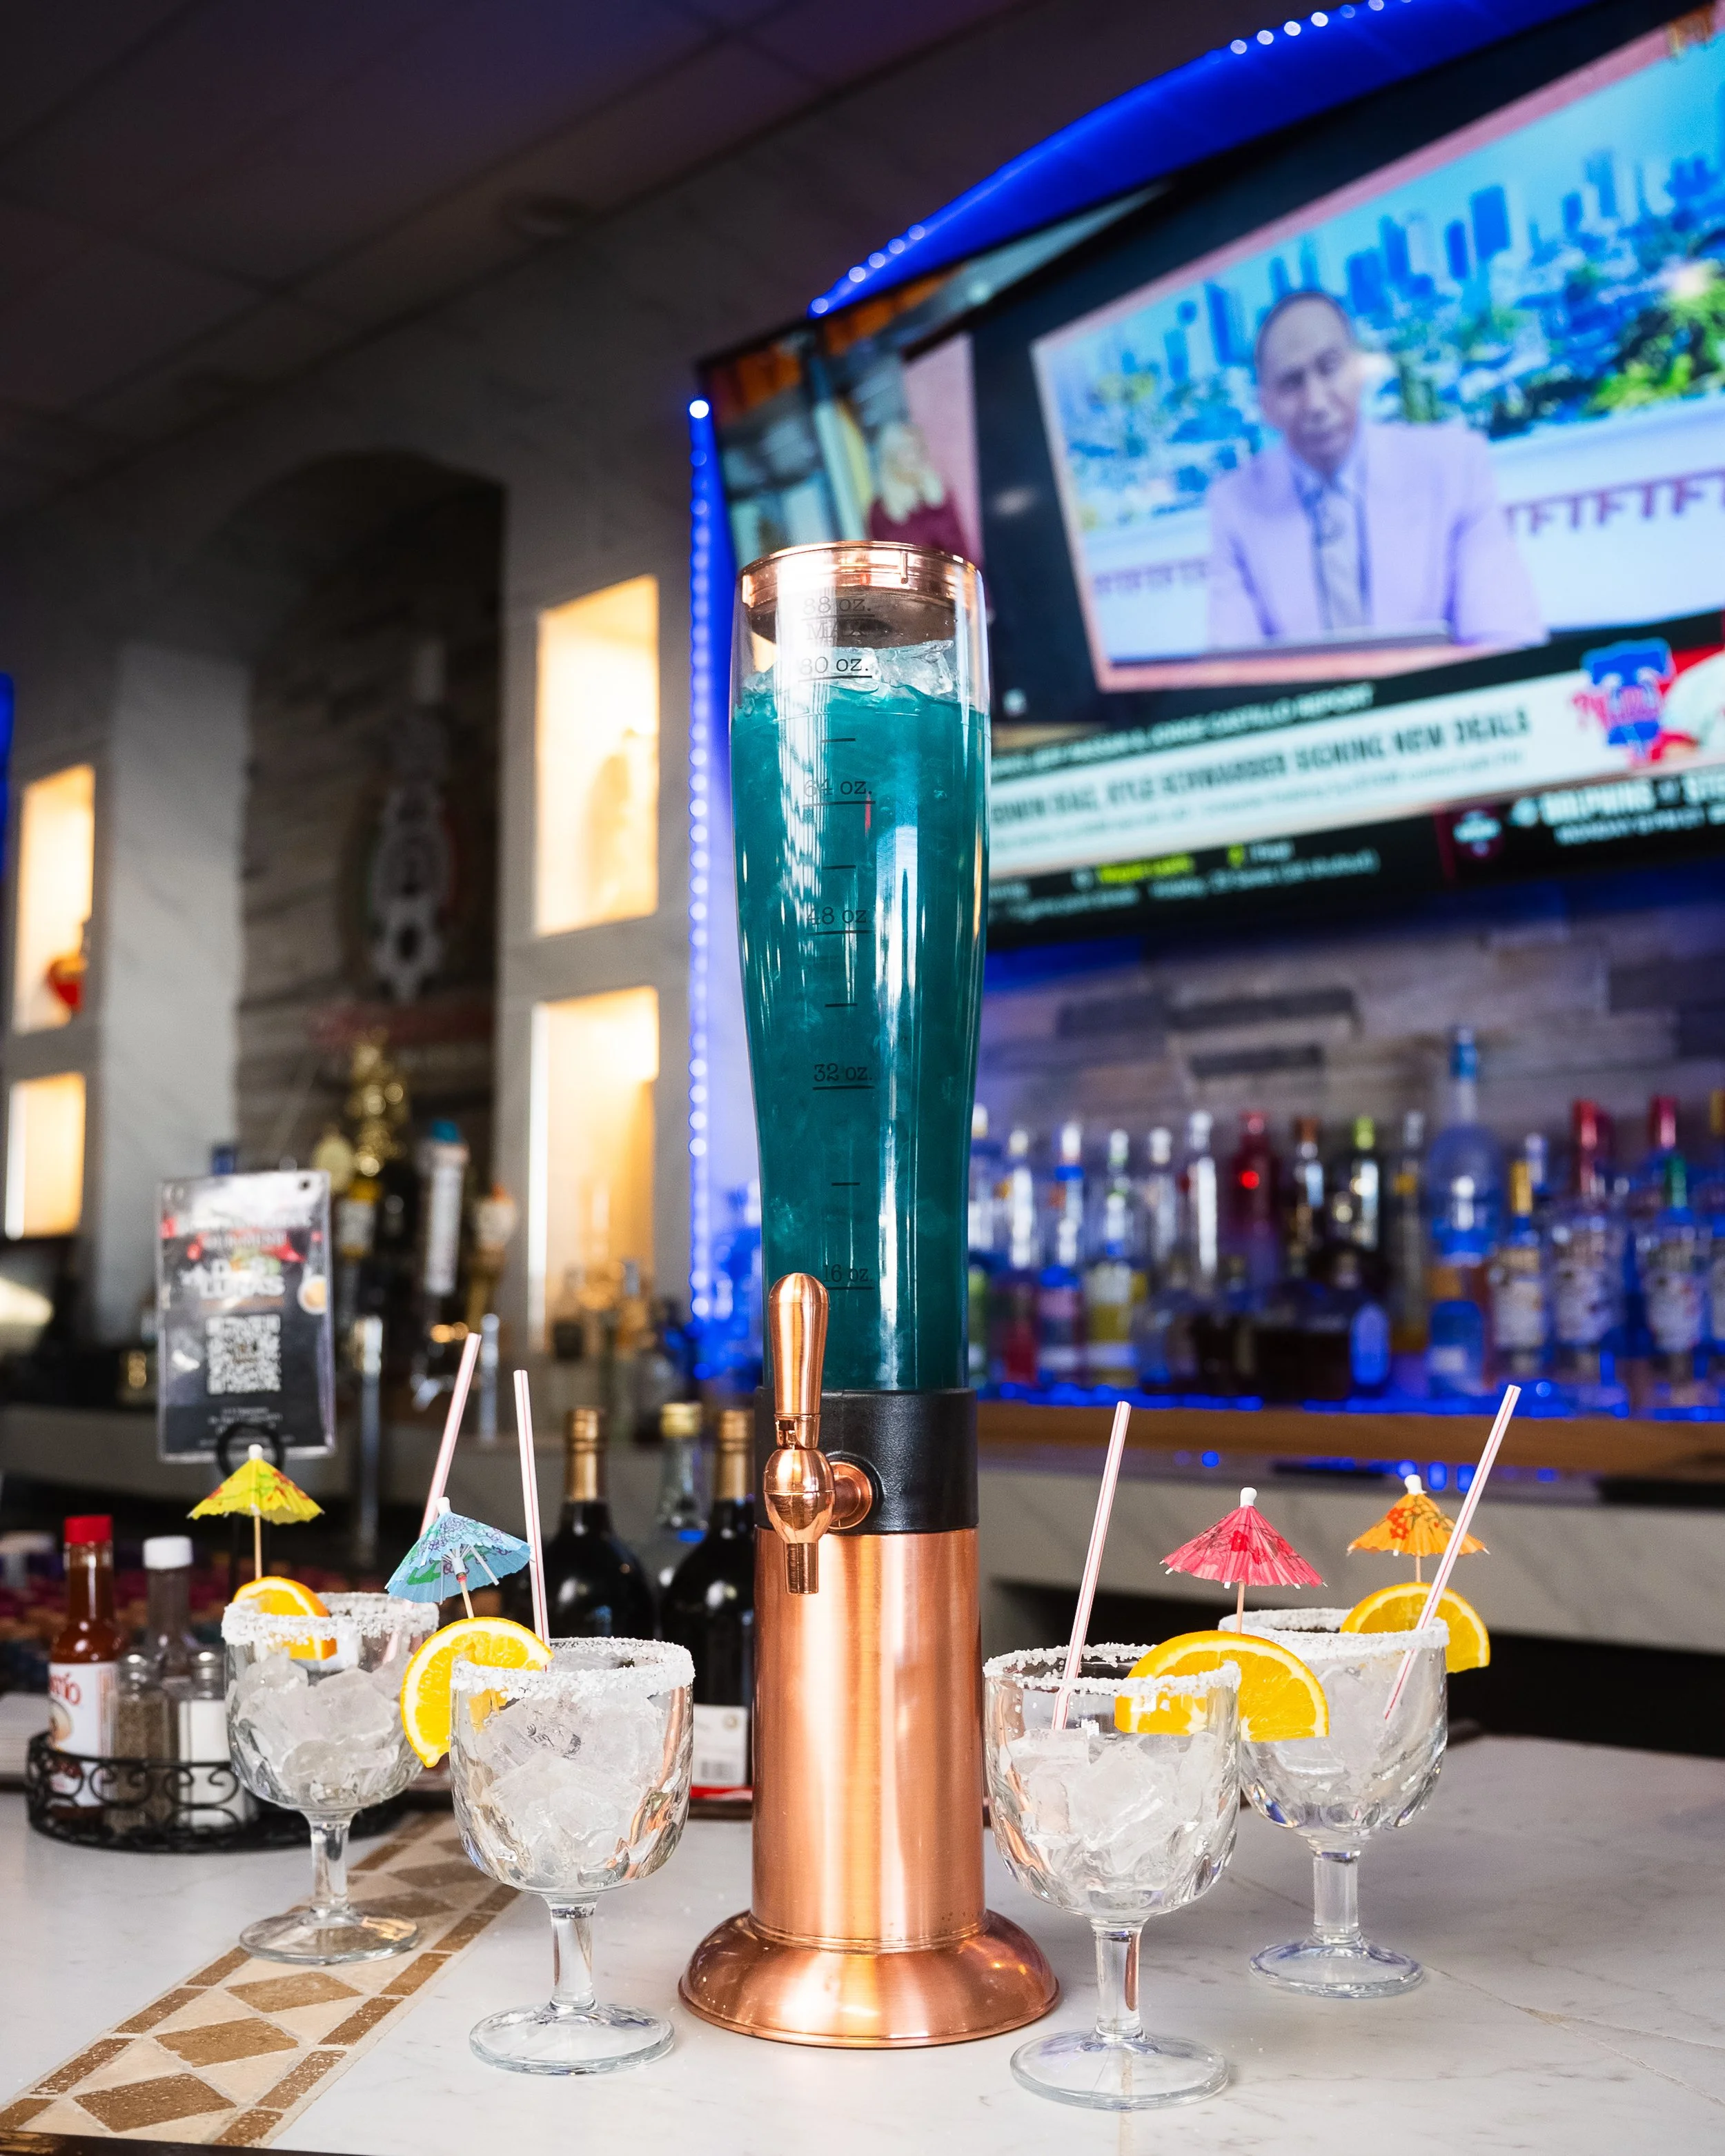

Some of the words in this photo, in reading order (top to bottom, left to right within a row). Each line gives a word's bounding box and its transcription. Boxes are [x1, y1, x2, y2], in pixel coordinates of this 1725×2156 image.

[803, 596, 831, 615] 88
[839, 598, 871, 612] oz.
[800, 656, 829, 675] 80
[836, 658, 869, 672] oz.
[803, 778, 833, 798] 64
[840, 780, 873, 795] oz.
[807, 906, 834, 925] 48
[814, 1063, 839, 1082] 32
[846, 1067, 872, 1081] oz.
[823, 1263, 842, 1283] 16
[849, 1268, 873, 1283] oz.
